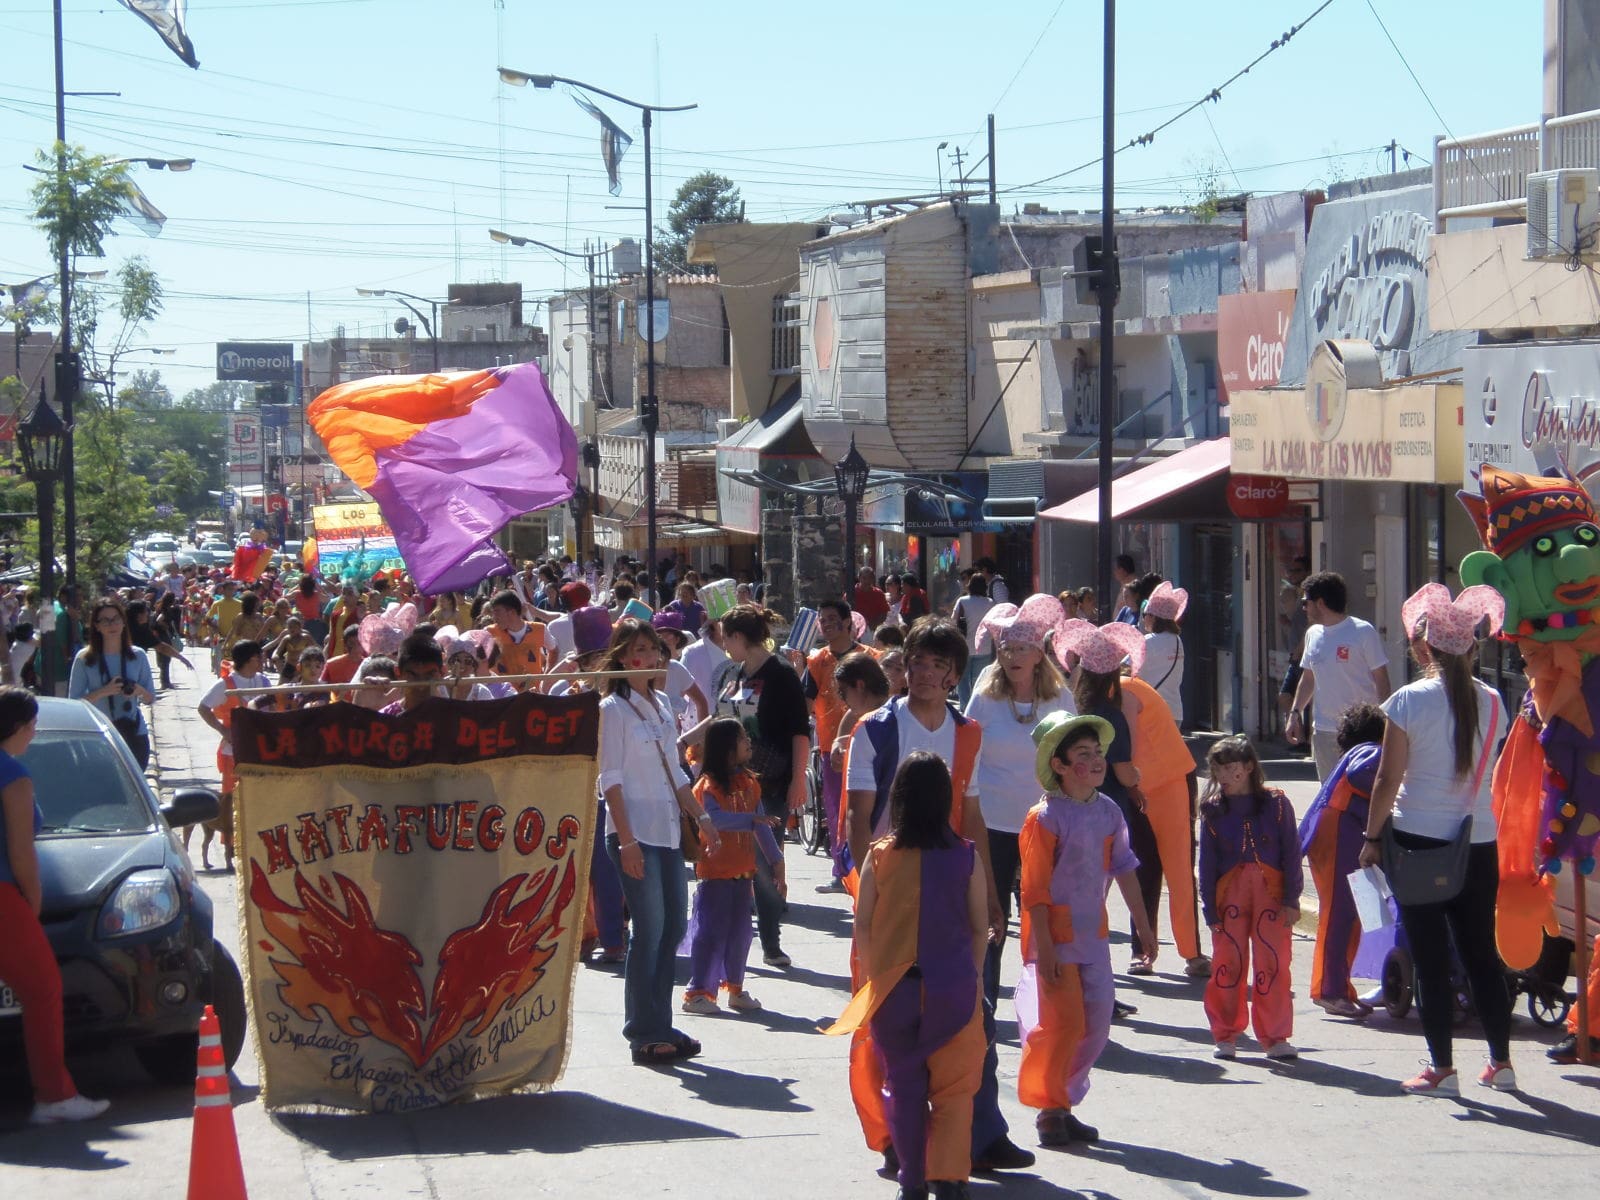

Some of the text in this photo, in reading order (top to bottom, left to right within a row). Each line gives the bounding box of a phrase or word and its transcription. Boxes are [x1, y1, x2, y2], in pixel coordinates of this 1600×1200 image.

[1246, 333, 1284, 382] Claro
[1262, 440, 1277, 472] LA
[1280, 440, 1307, 474] CASA
[1310, 441, 1325, 476] DE
[1468, 442, 1512, 463] TAVERNITI
[1235, 486, 1277, 499] Claro
[342, 509, 366, 520] LOS
[256, 709, 585, 762] LA MURGA DEL GET
[257, 800, 582, 876] MATAFUEGOS
[487, 994, 556, 1063] Gracia
